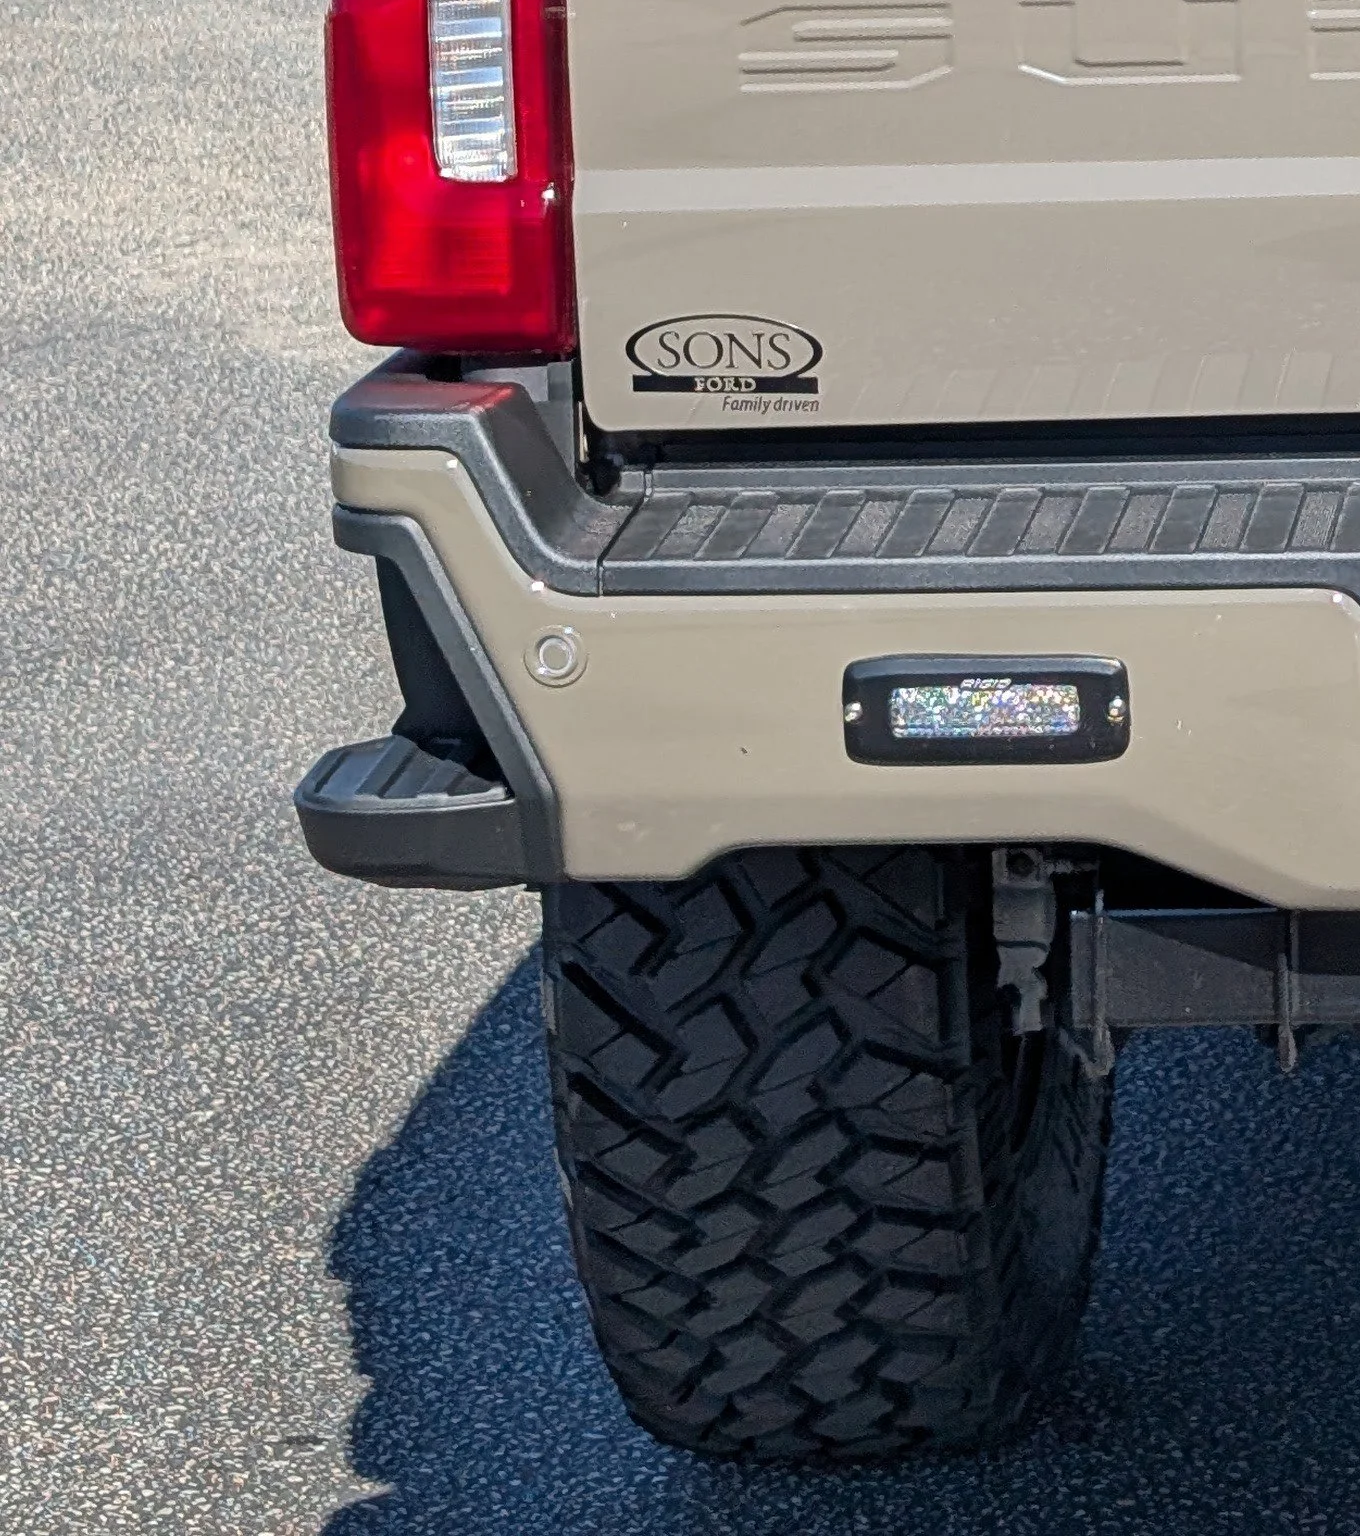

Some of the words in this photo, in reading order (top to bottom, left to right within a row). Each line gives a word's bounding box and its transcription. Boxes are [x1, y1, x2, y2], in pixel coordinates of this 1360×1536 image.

[657, 331, 791, 370] SONS
[694, 377, 757, 392] FORD
[722, 395, 771, 414] Family
[773, 397, 819, 412] driven
